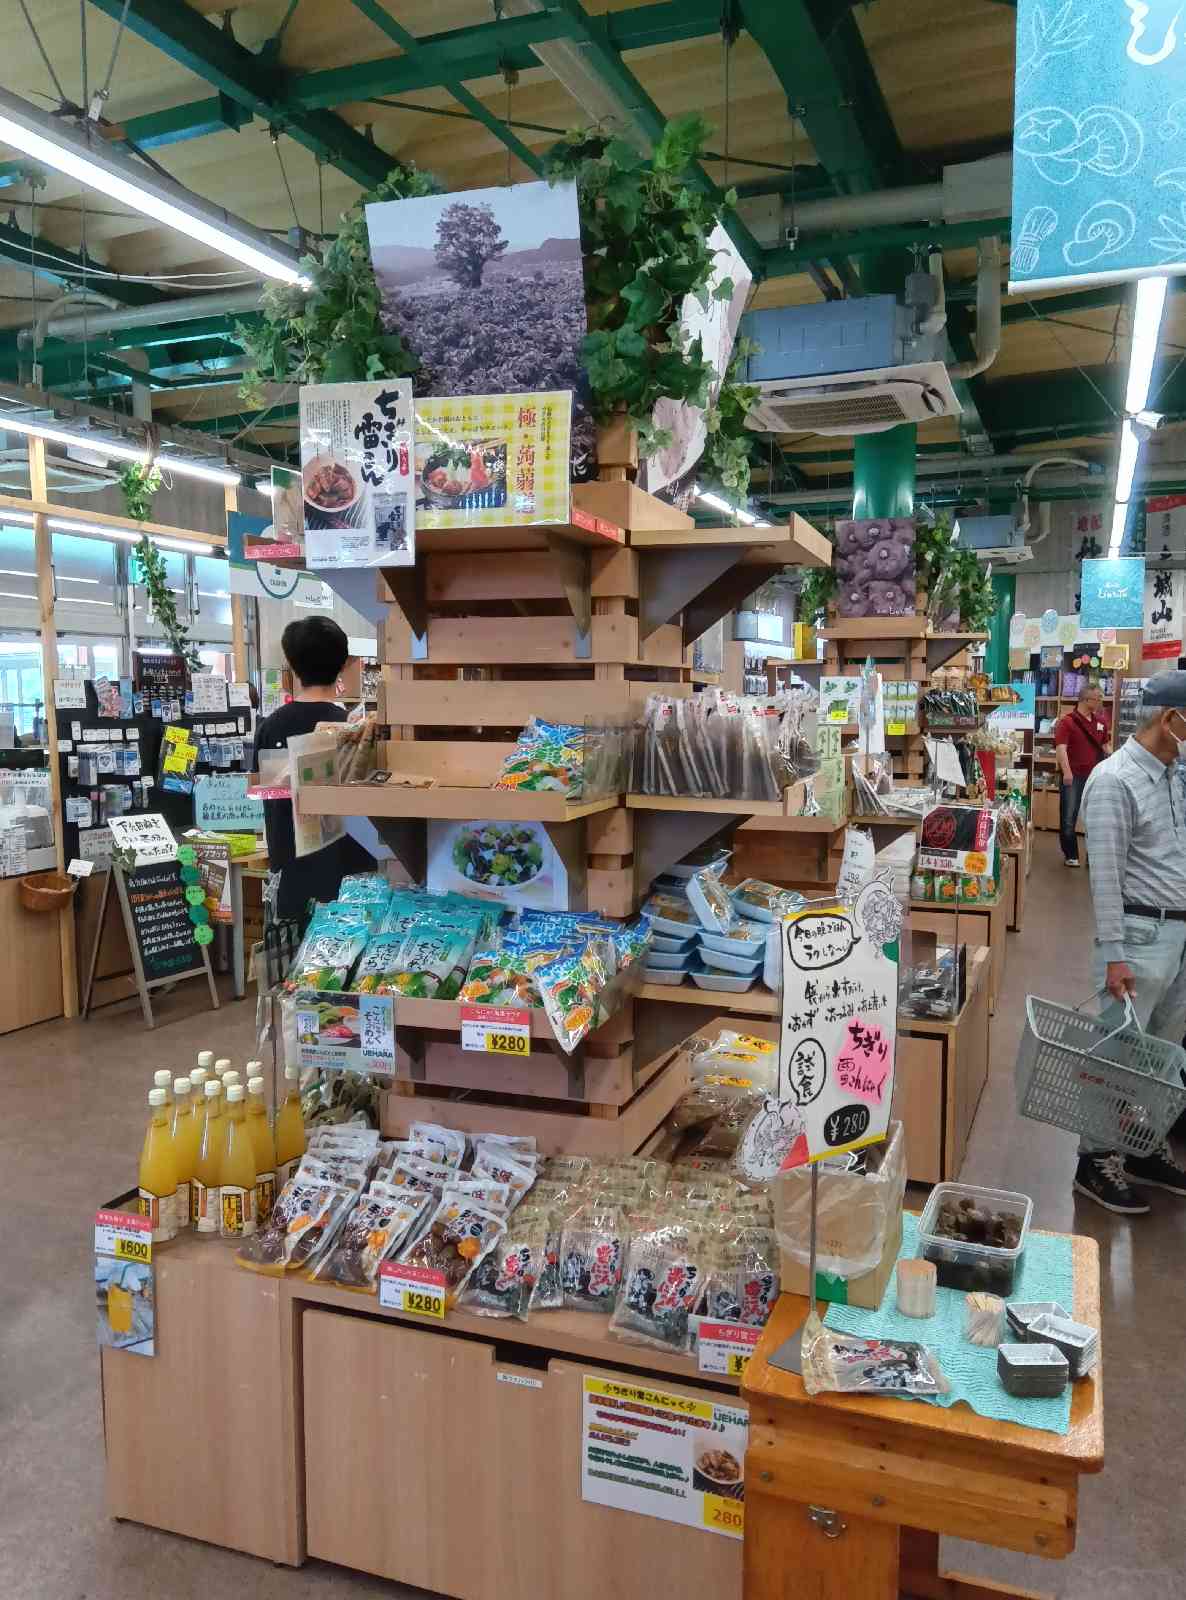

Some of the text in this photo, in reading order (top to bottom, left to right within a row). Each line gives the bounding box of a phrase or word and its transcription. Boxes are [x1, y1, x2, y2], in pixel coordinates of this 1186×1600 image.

[491, 1033, 526, 1051] ¥280
[829, 1110, 867, 1142] ¥280
[120, 1239, 148, 1257] ¥600
[408, 1291, 442, 1312] ¥280
